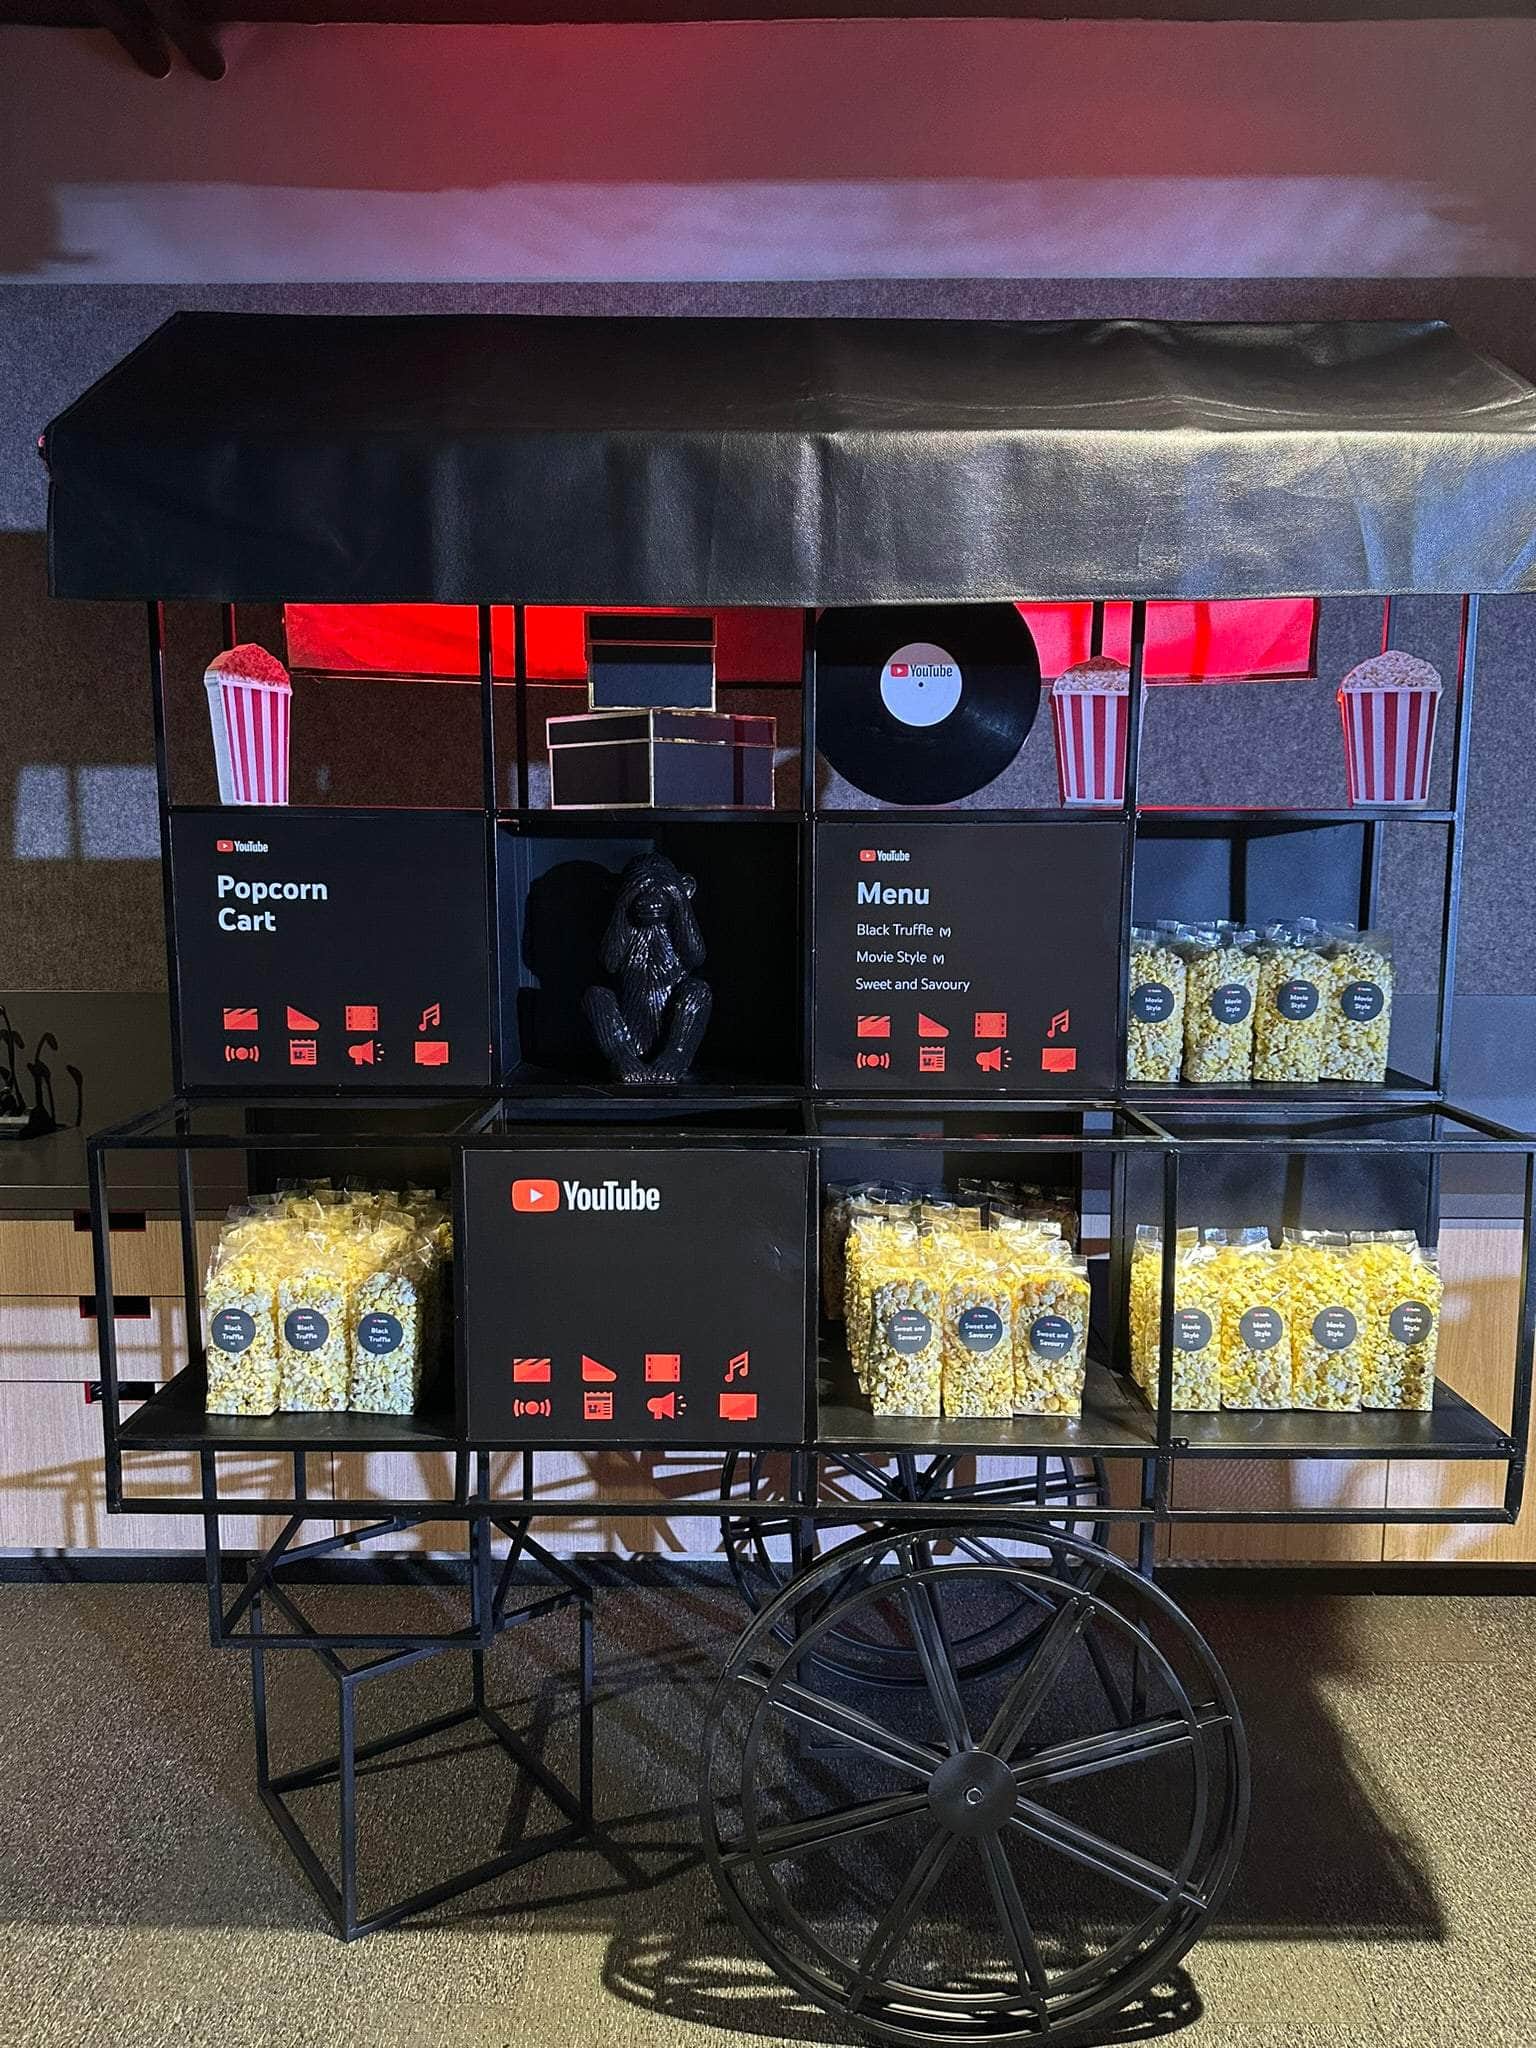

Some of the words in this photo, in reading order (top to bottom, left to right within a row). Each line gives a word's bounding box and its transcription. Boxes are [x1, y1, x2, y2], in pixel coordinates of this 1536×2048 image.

[910, 664, 953, 677] YouTube
[233, 840, 269, 853] YouTube
[877, 850, 910, 861] YouTube
[217, 874, 328, 904] Popcorn
[857, 881, 930, 905] Menu
[218, 907, 277, 931] Cart
[857, 923, 890, 936] Black
[893, 923, 934, 936] Truffle
[856, 950, 894, 963] Movie
[896, 950, 927, 965] Style
[855, 977, 892, 990] Sweet
[894, 977, 918, 990] and
[920, 977, 971, 993] Savoury
[562, 1179, 661, 1211] YouTube
